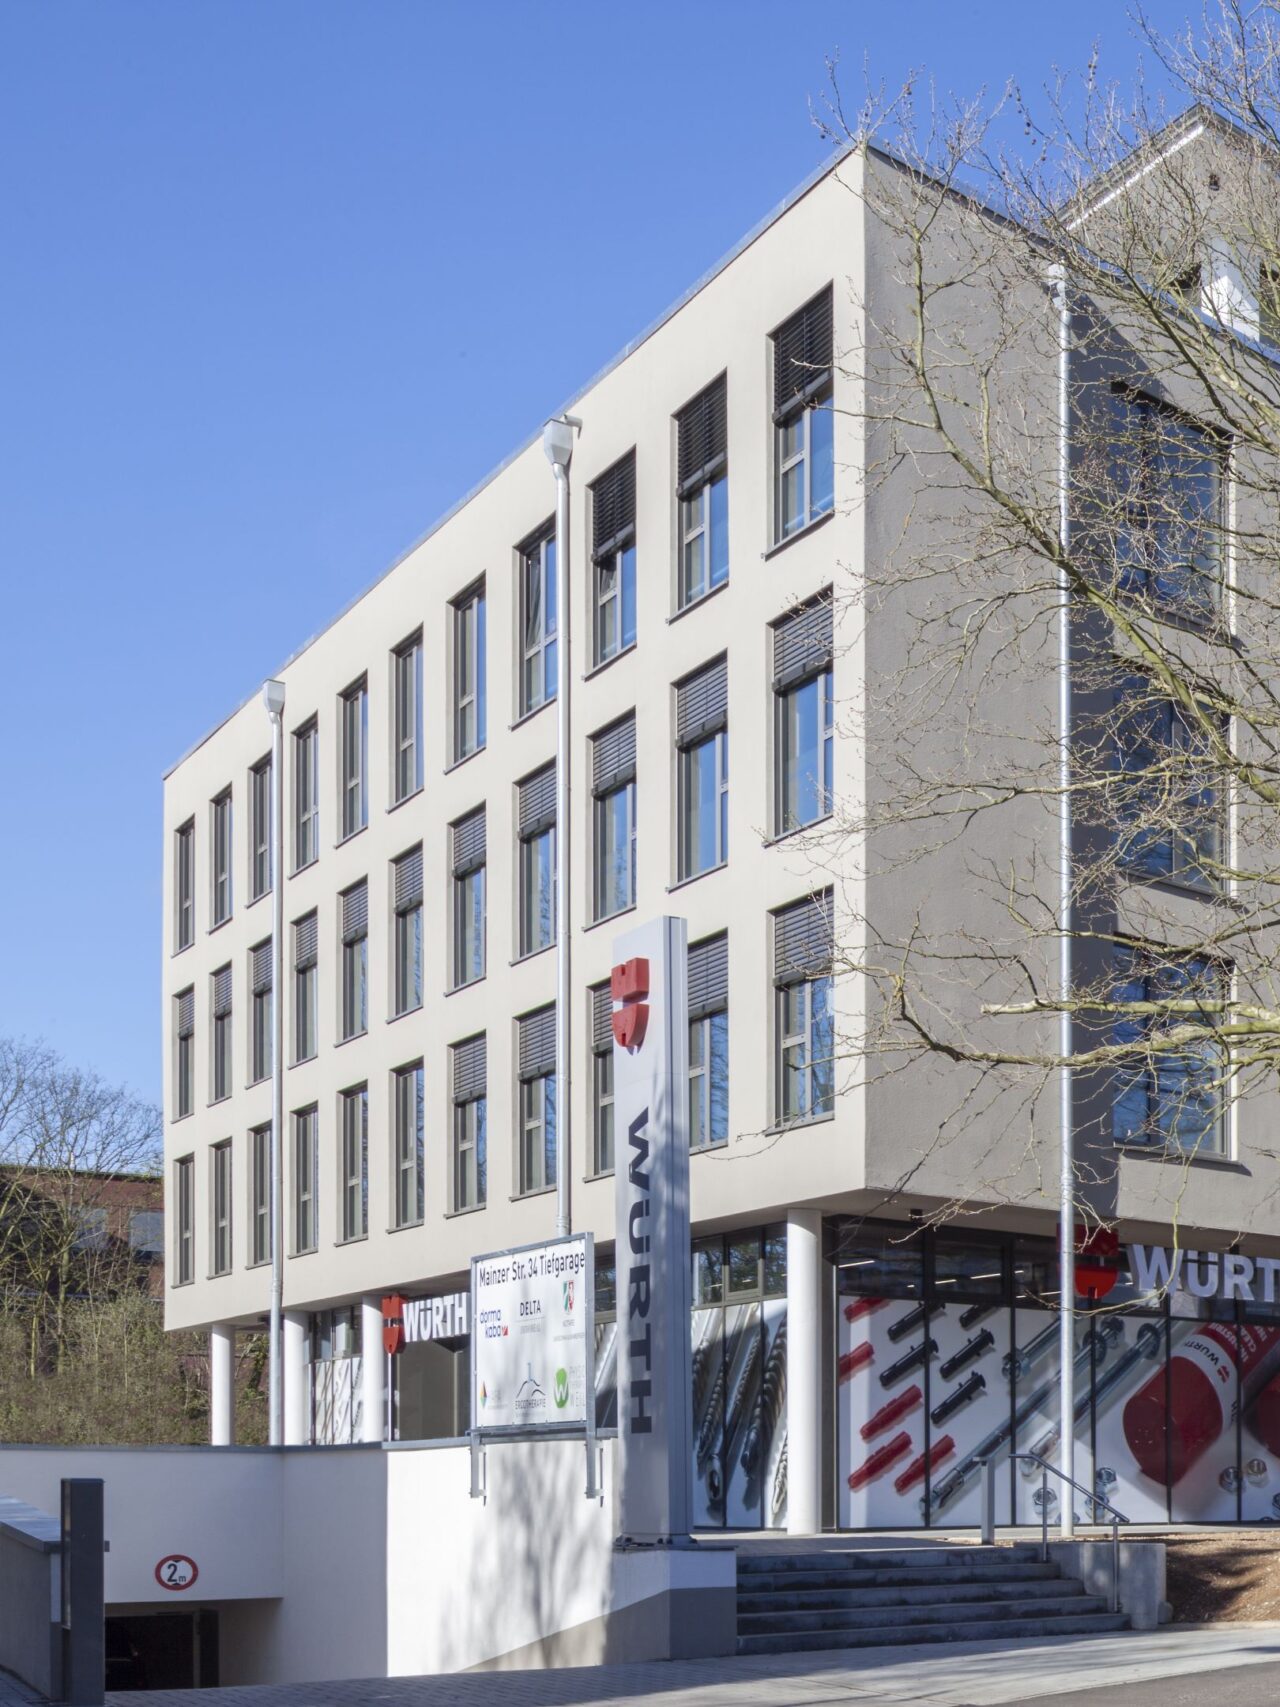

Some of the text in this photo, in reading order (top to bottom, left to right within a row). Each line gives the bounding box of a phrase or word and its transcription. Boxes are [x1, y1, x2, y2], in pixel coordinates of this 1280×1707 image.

[480, 1252, 585, 1287] Mainzer Str. 34 Tiefgarage
[628, 1106, 652, 1435] WÜRTH
[402, 1292, 468, 1342] WÜRTH
[480, 1309, 501, 1324] dorma
[520, 1300, 541, 1316] DELTA
